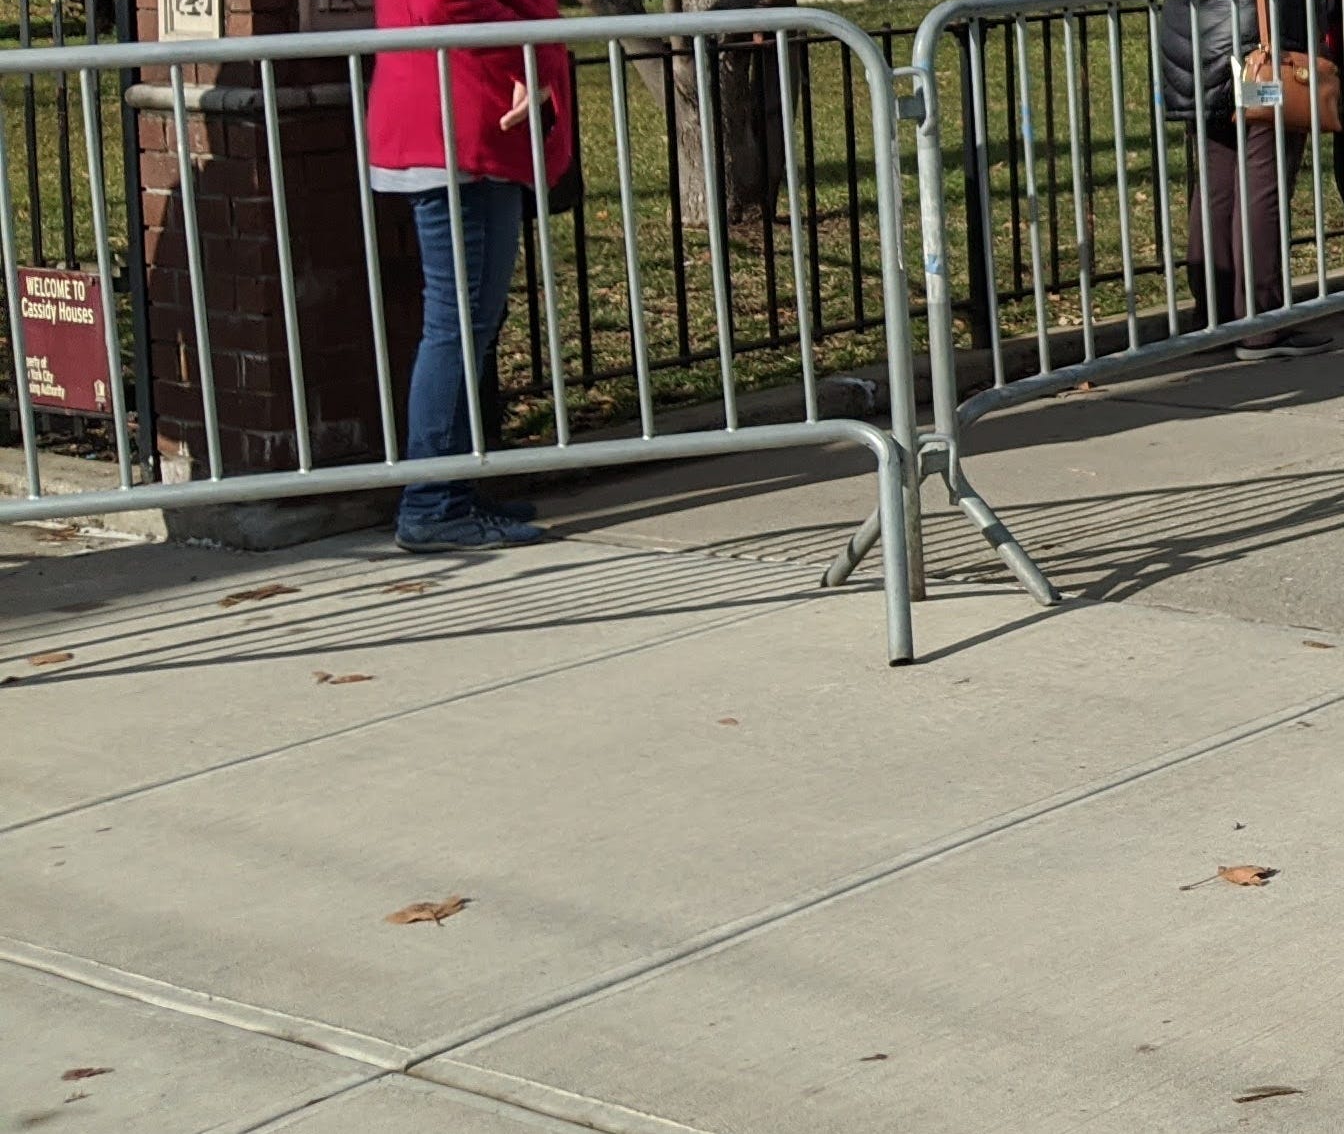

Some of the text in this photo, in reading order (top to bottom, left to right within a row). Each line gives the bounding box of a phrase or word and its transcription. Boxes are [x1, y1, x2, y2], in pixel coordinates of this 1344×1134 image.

[25, 275, 86, 302] WELCOME TO
[21, 297, 94, 325] Cassidy Houses
